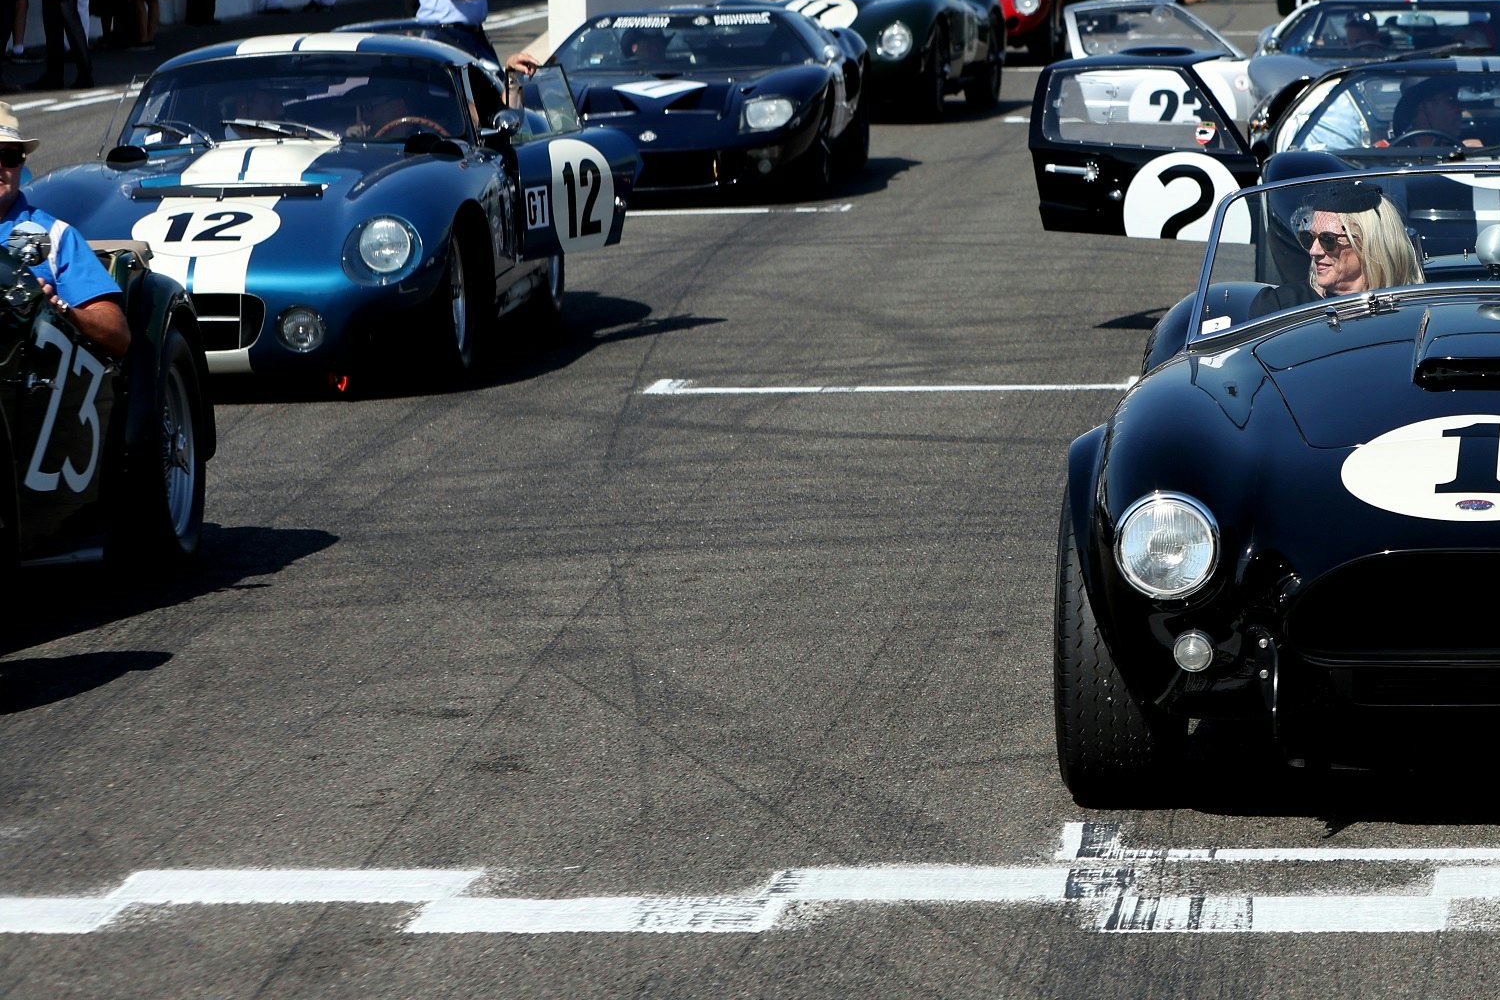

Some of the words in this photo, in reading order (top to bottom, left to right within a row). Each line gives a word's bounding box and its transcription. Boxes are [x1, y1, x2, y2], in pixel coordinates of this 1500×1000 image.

[163, 211, 254, 243] 12
[527, 191, 546, 226] GT
[562, 158, 602, 239] 12
[1157, 164, 1216, 240] 2
[24, 321, 105, 493] 23
